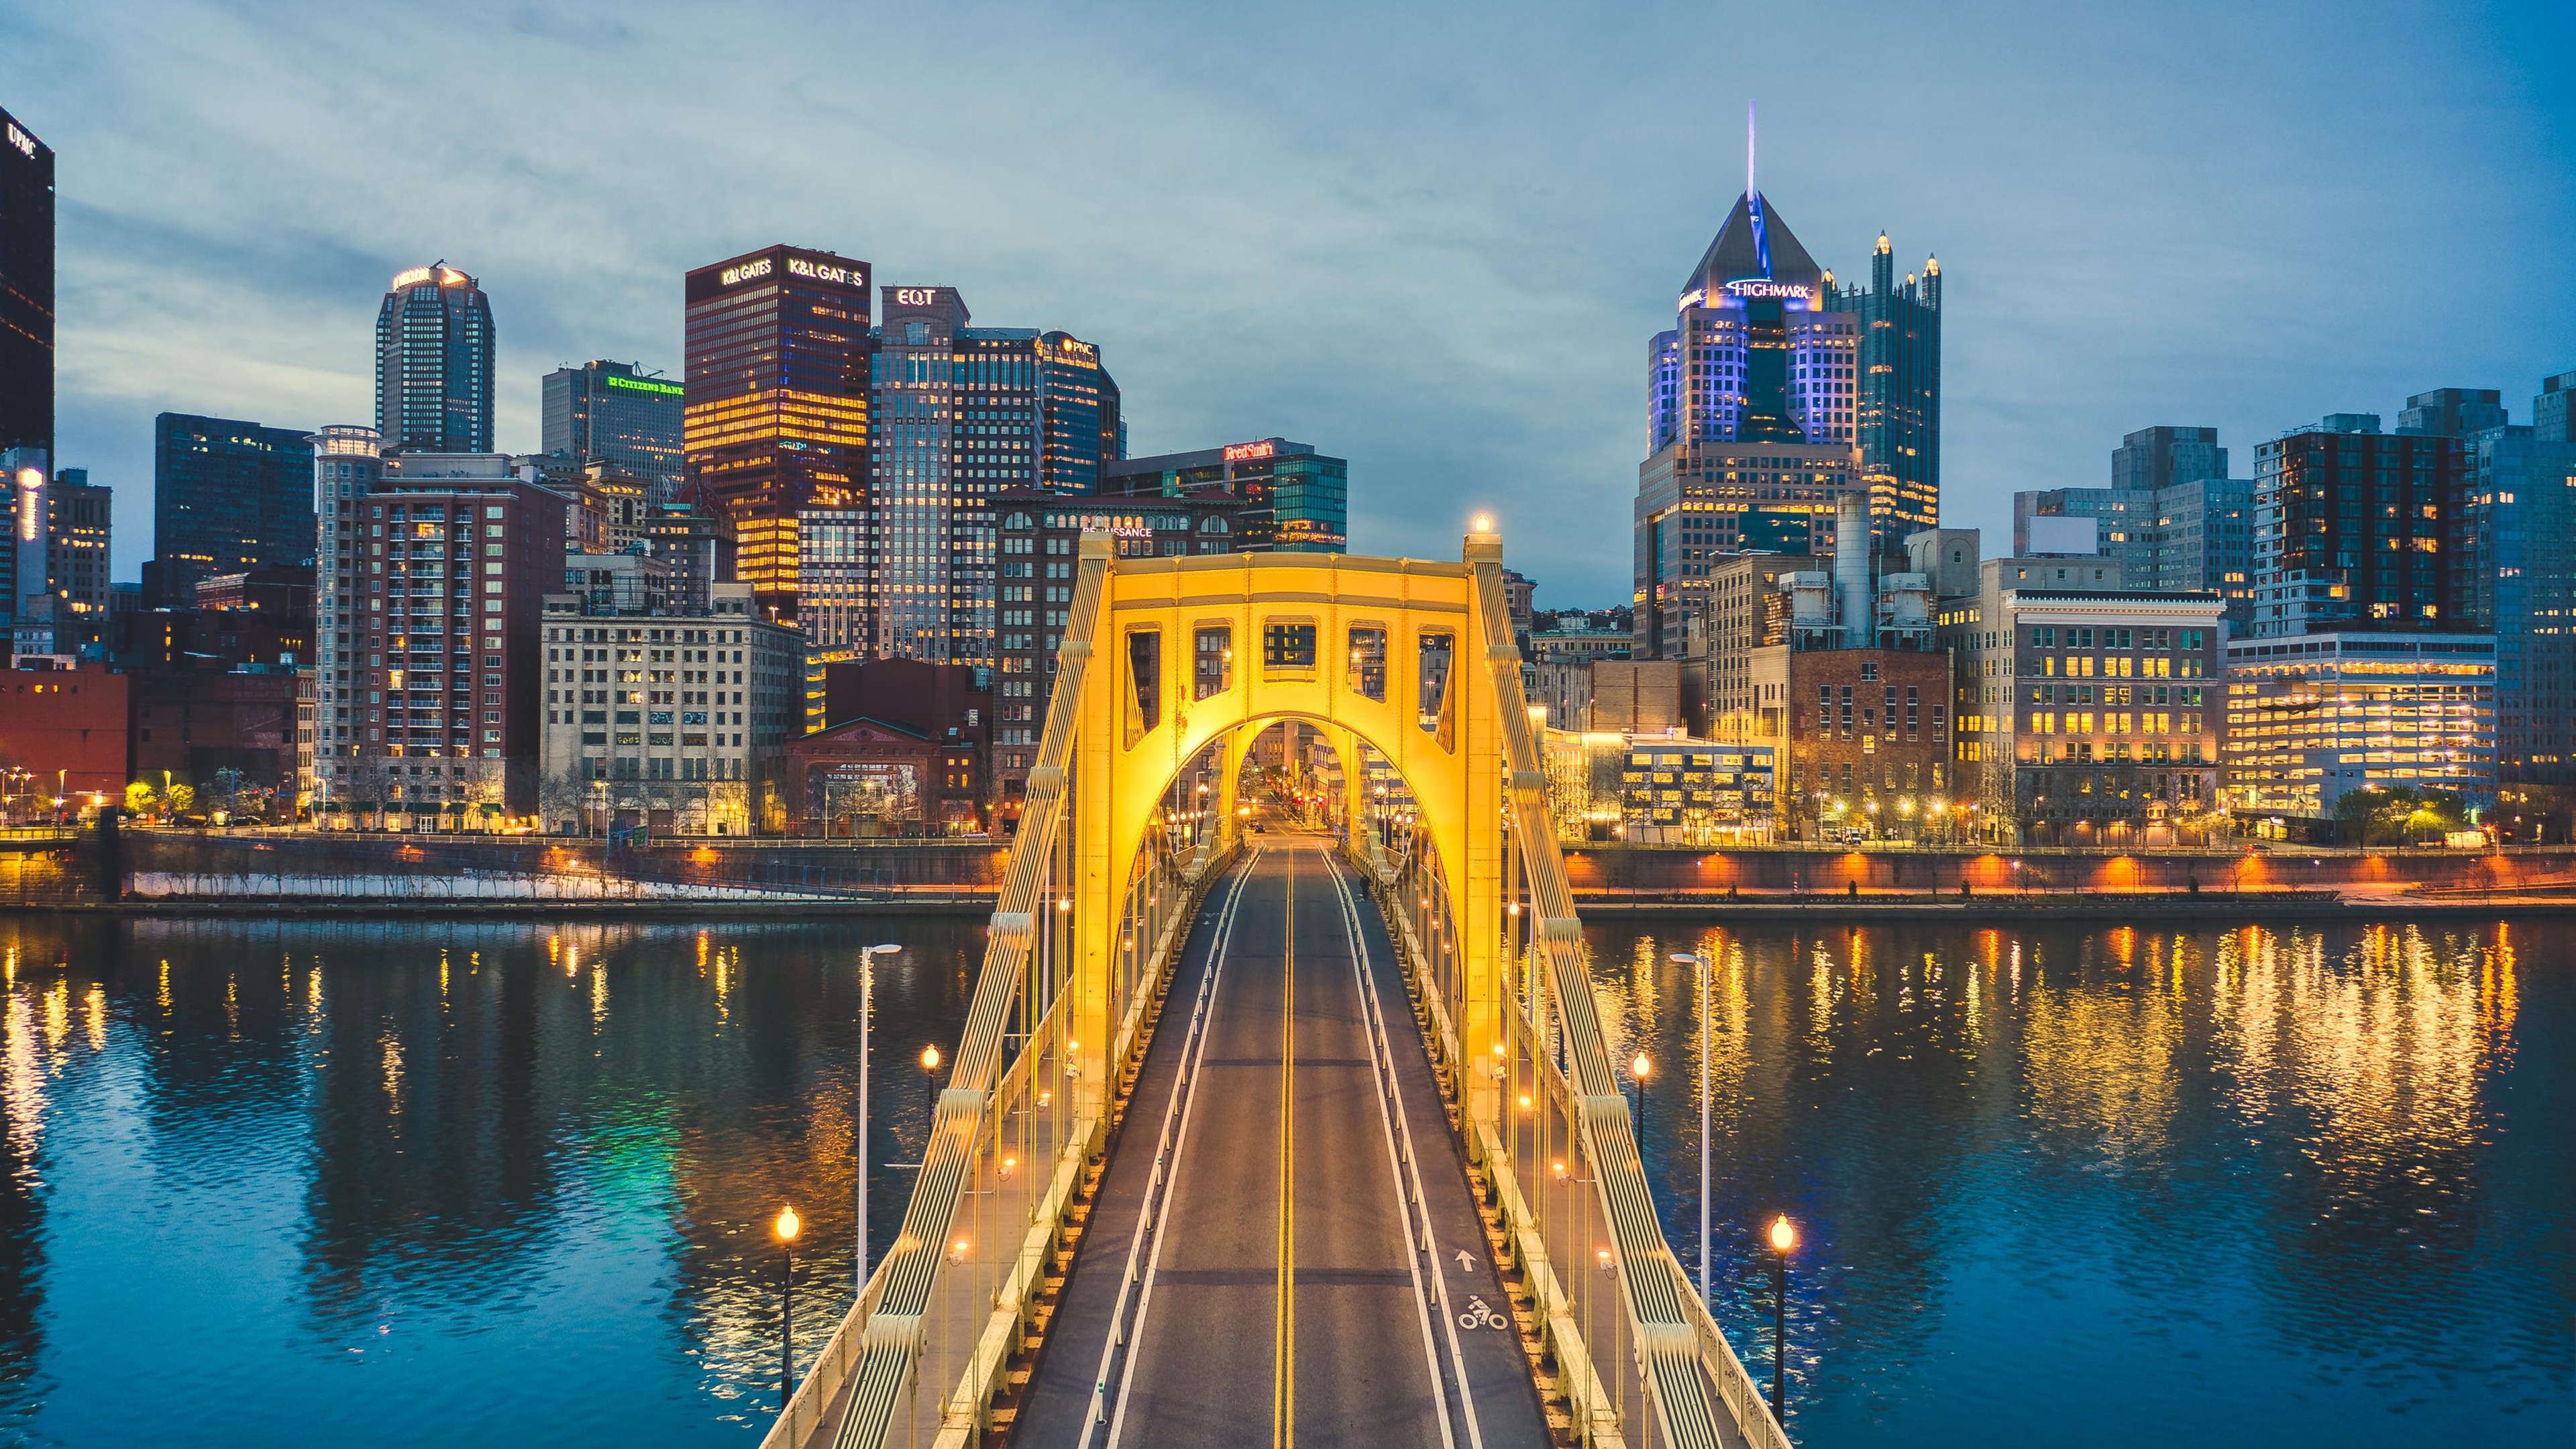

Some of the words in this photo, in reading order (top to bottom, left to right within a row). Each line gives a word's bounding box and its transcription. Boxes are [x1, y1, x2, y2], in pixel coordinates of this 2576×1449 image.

[7, 123, 36, 160] UPMC
[723, 268, 741, 285] K&L
[741, 259, 771, 280] GATES
[790, 259, 816, 278] K&L
[818, 264, 863, 286] GATES
[897, 288, 936, 306] EQT
[1735, 283, 1809, 299] HIGHMARK
[1073, 341, 1093, 356] PNC
[1225, 445, 1247, 460] Reed
[1248, 441, 1273, 458] Smith
